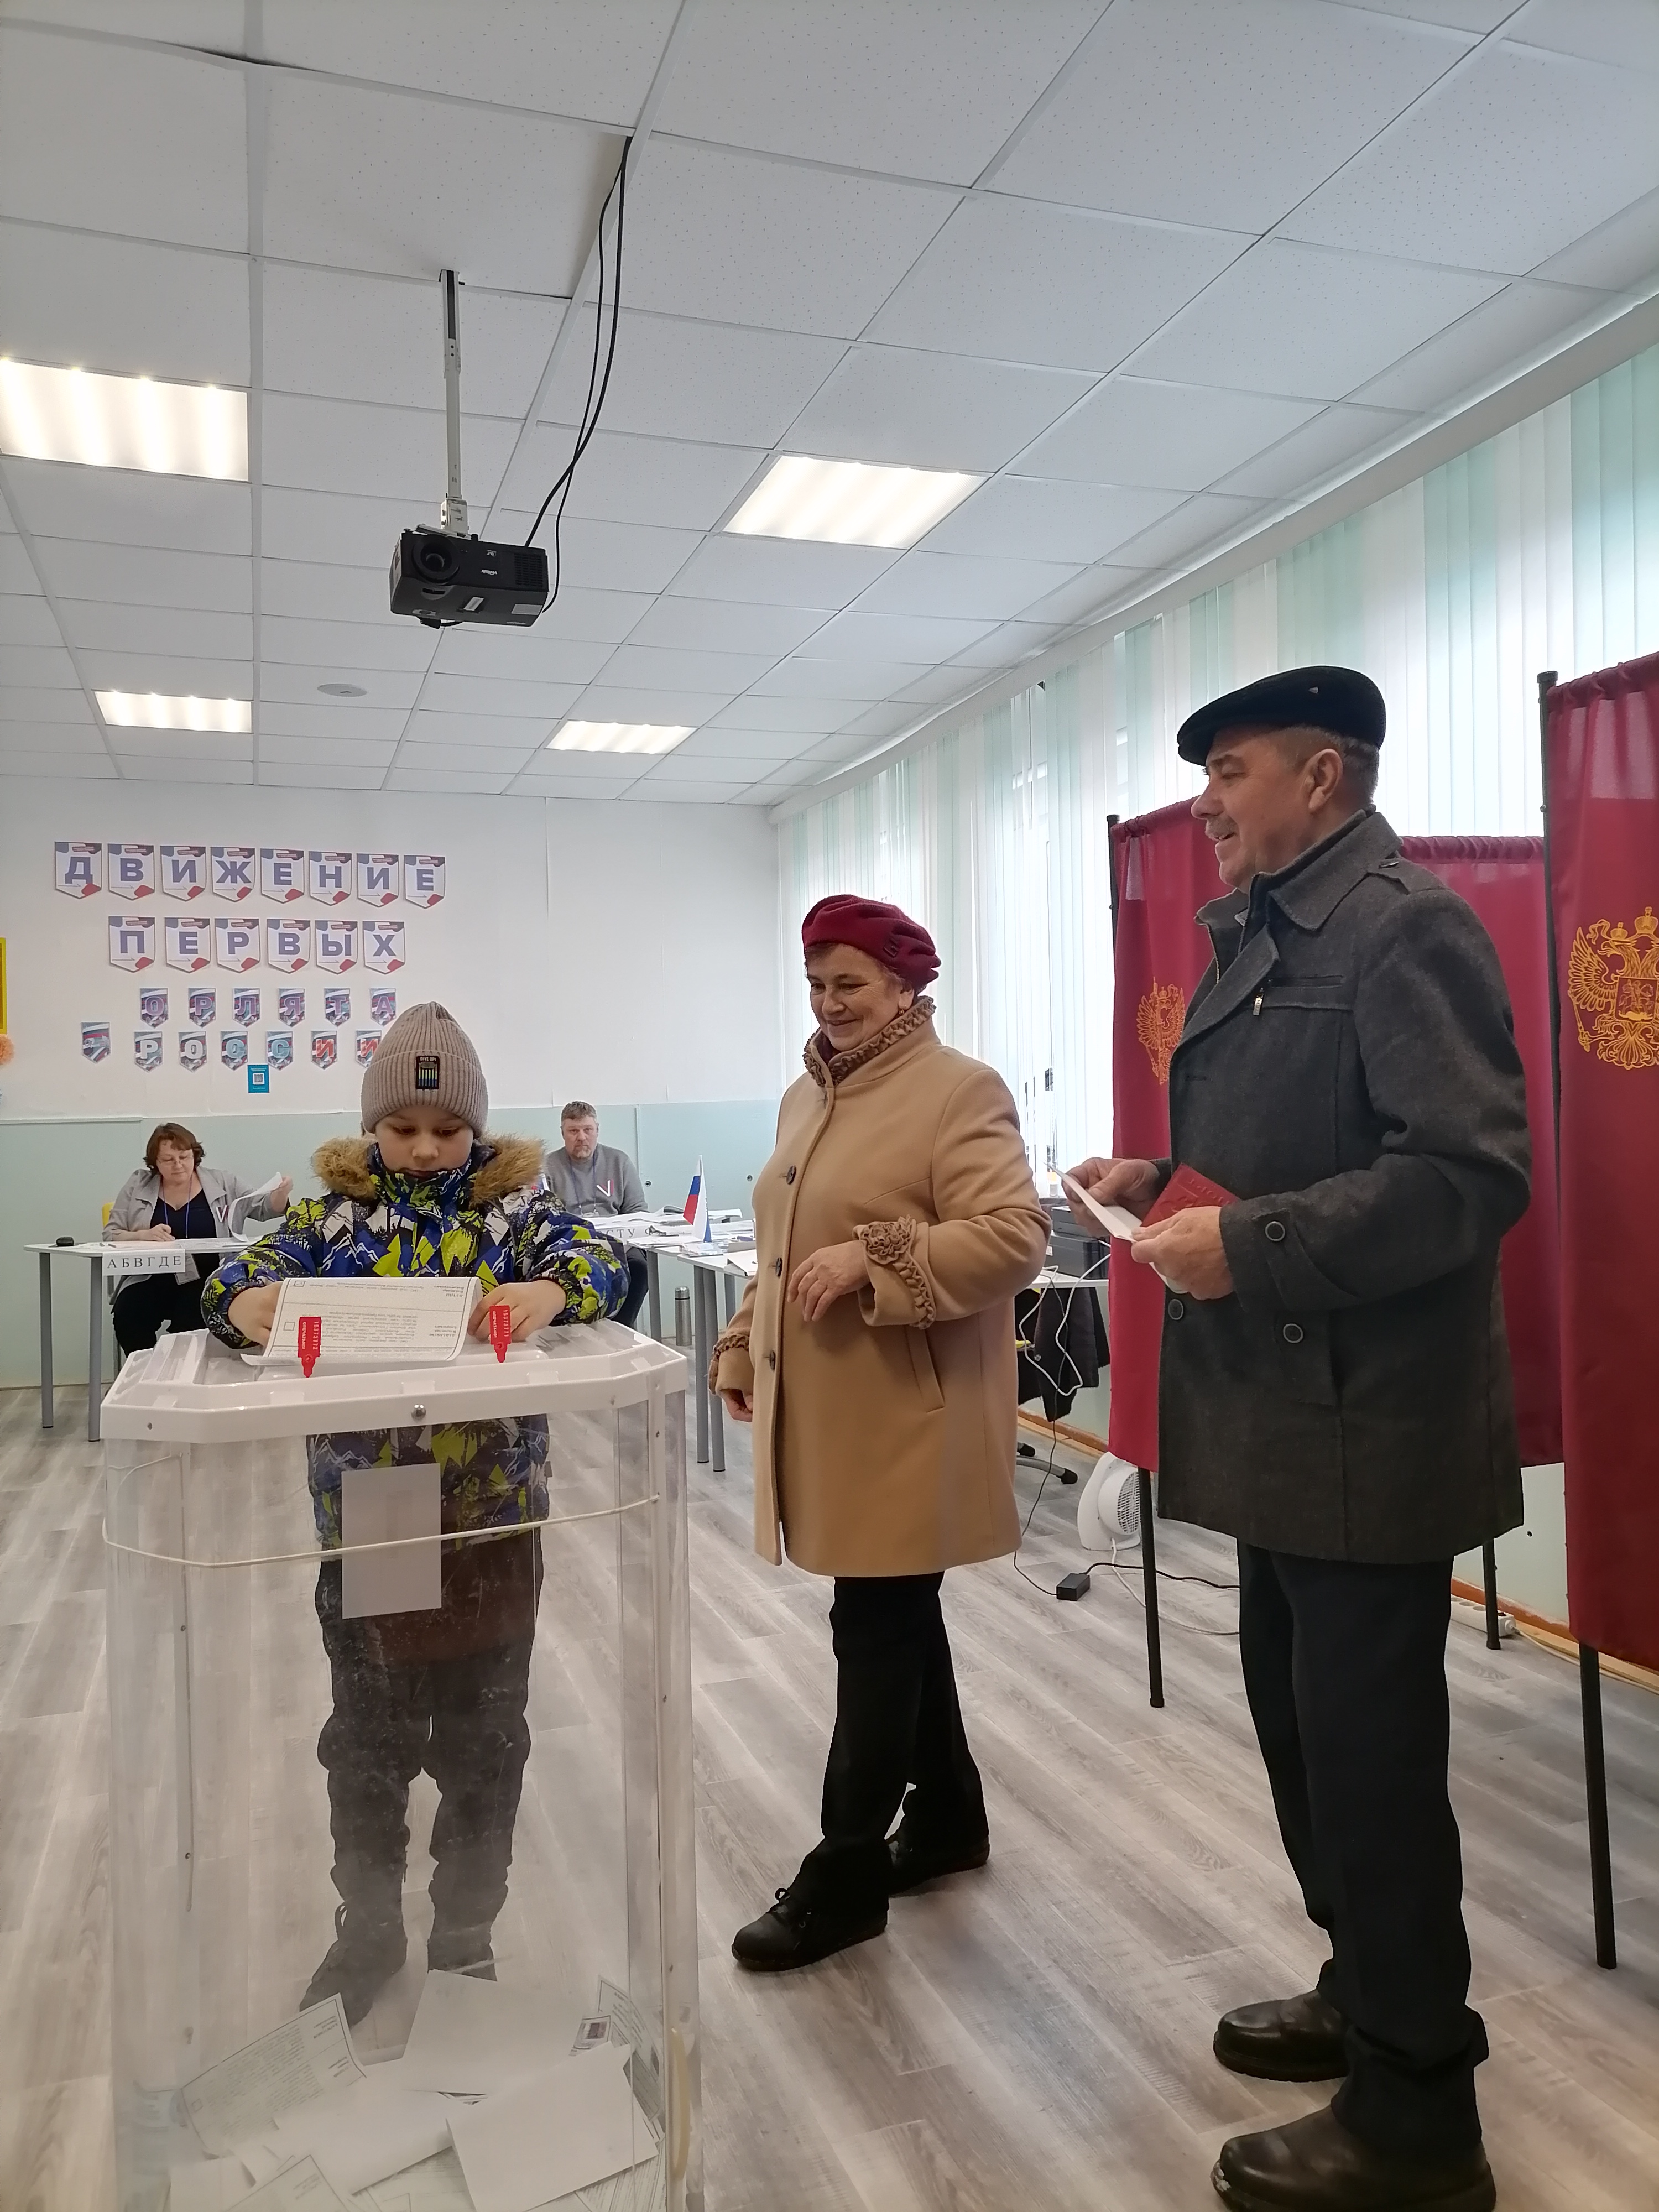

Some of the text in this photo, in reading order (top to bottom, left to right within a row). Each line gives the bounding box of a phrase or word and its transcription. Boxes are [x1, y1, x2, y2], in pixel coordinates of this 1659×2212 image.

[65, 856, 434, 891] ДВИЖЕНИЕ
[119, 930, 397, 957] ПЕРВЫХ
[144, 996, 394, 1016] ОРЛЯТА
[140, 1038, 379, 1060] РОССИИ
[107, 1255, 181, 1269] АБВГДЕ
